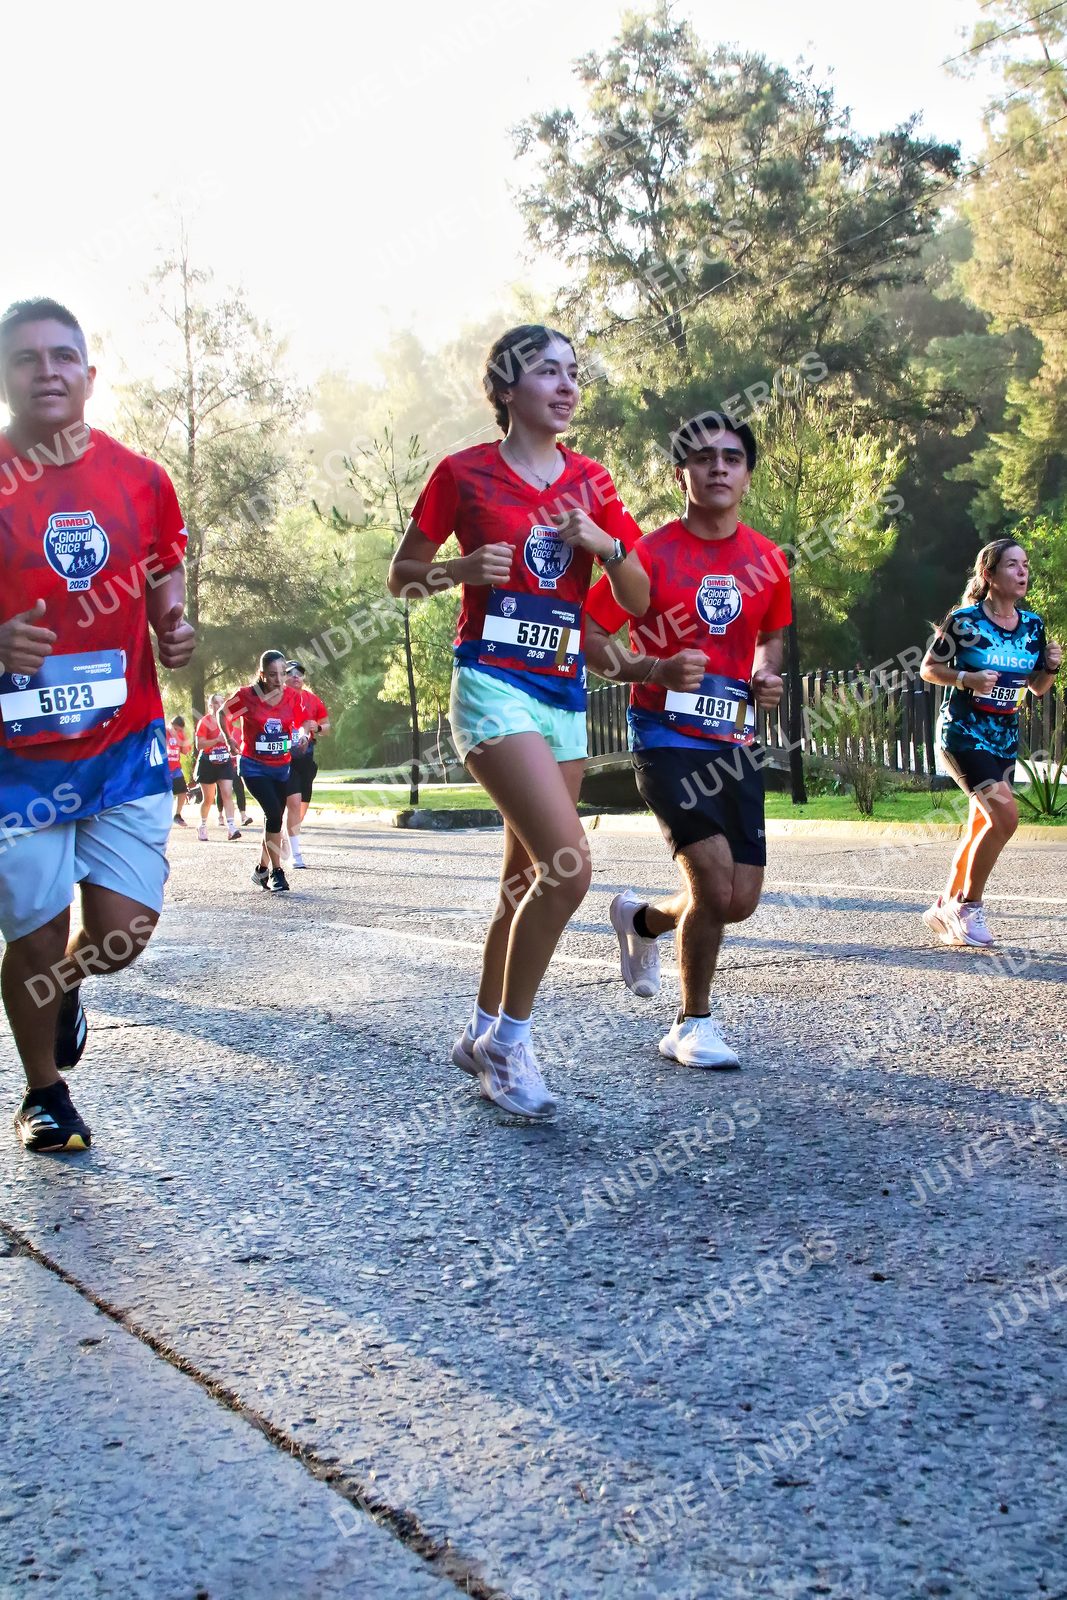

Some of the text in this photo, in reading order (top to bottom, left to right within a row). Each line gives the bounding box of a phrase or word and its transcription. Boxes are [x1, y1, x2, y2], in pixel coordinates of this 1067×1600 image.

[55, 518, 90, 528] BIMBO
[59, 530, 91, 543] Global
[54, 543, 80, 554] Race
[537, 540, 563, 551] Global
[532, 548, 552, 558] Race
[69, 580, 89, 589] 2026
[540, 580, 556, 588] 2026
[708, 590, 731, 598] Global
[703, 597, 721, 606] Race
[516, 622, 559, 649] 5376
[527, 649, 545, 659] 20-26
[982, 654, 1035, 669] JALISCO
[557, 665, 570, 673] 10K
[991, 686, 1016, 700] 5638
[39, 684, 95, 714] 5623
[694, 696, 732, 720] 4031
[60, 714, 81, 725] 20-26
[703, 719, 720, 727] 20-26
